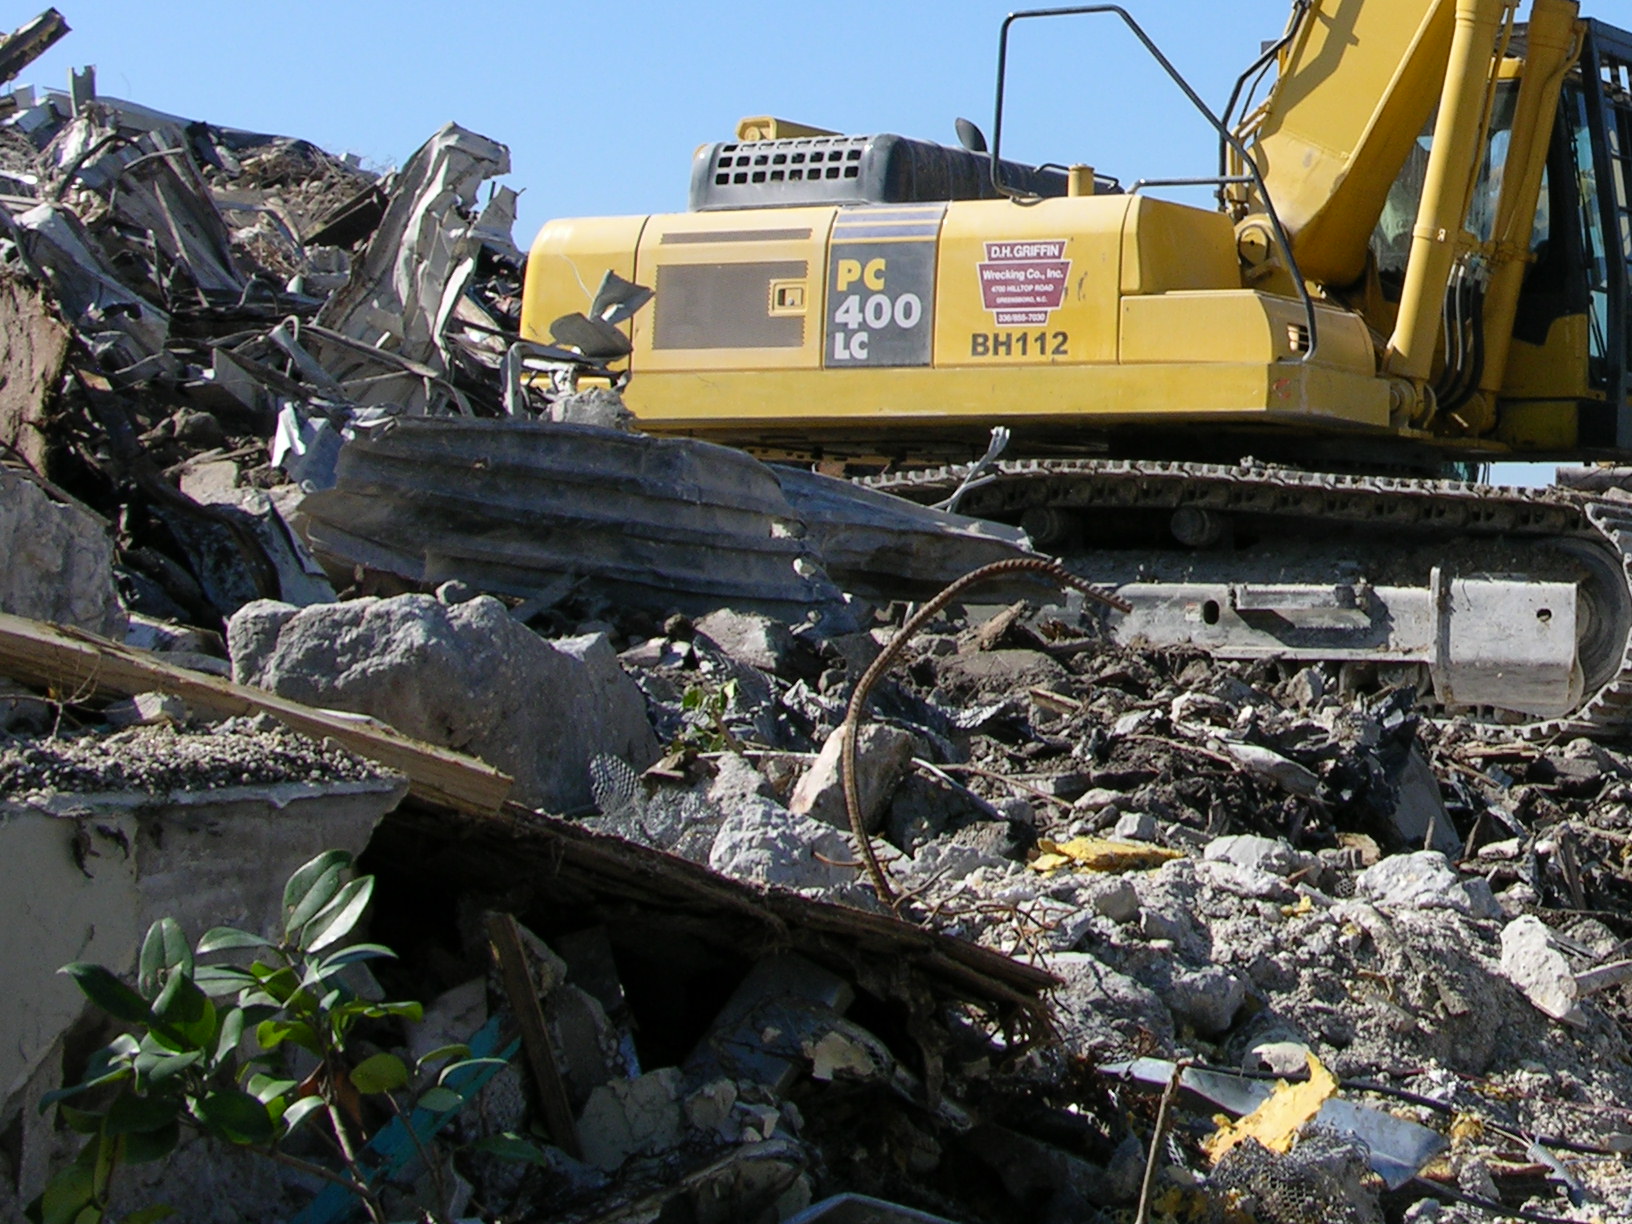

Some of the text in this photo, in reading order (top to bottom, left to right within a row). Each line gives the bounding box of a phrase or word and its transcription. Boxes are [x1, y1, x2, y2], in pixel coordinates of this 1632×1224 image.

[991, 244, 1059, 258] D.H. GRIFFIN
[837, 258, 886, 291] PC
[983, 269, 1025, 281] Wrecking
[1046, 268, 1063, 279] Inc.
[1007, 284, 1034, 293] HILLTOP
[1035, 284, 1054, 292] ROAD
[835, 293, 922, 329] 400
[834, 332, 868, 360] LC
[971, 331, 1068, 357] BH112
